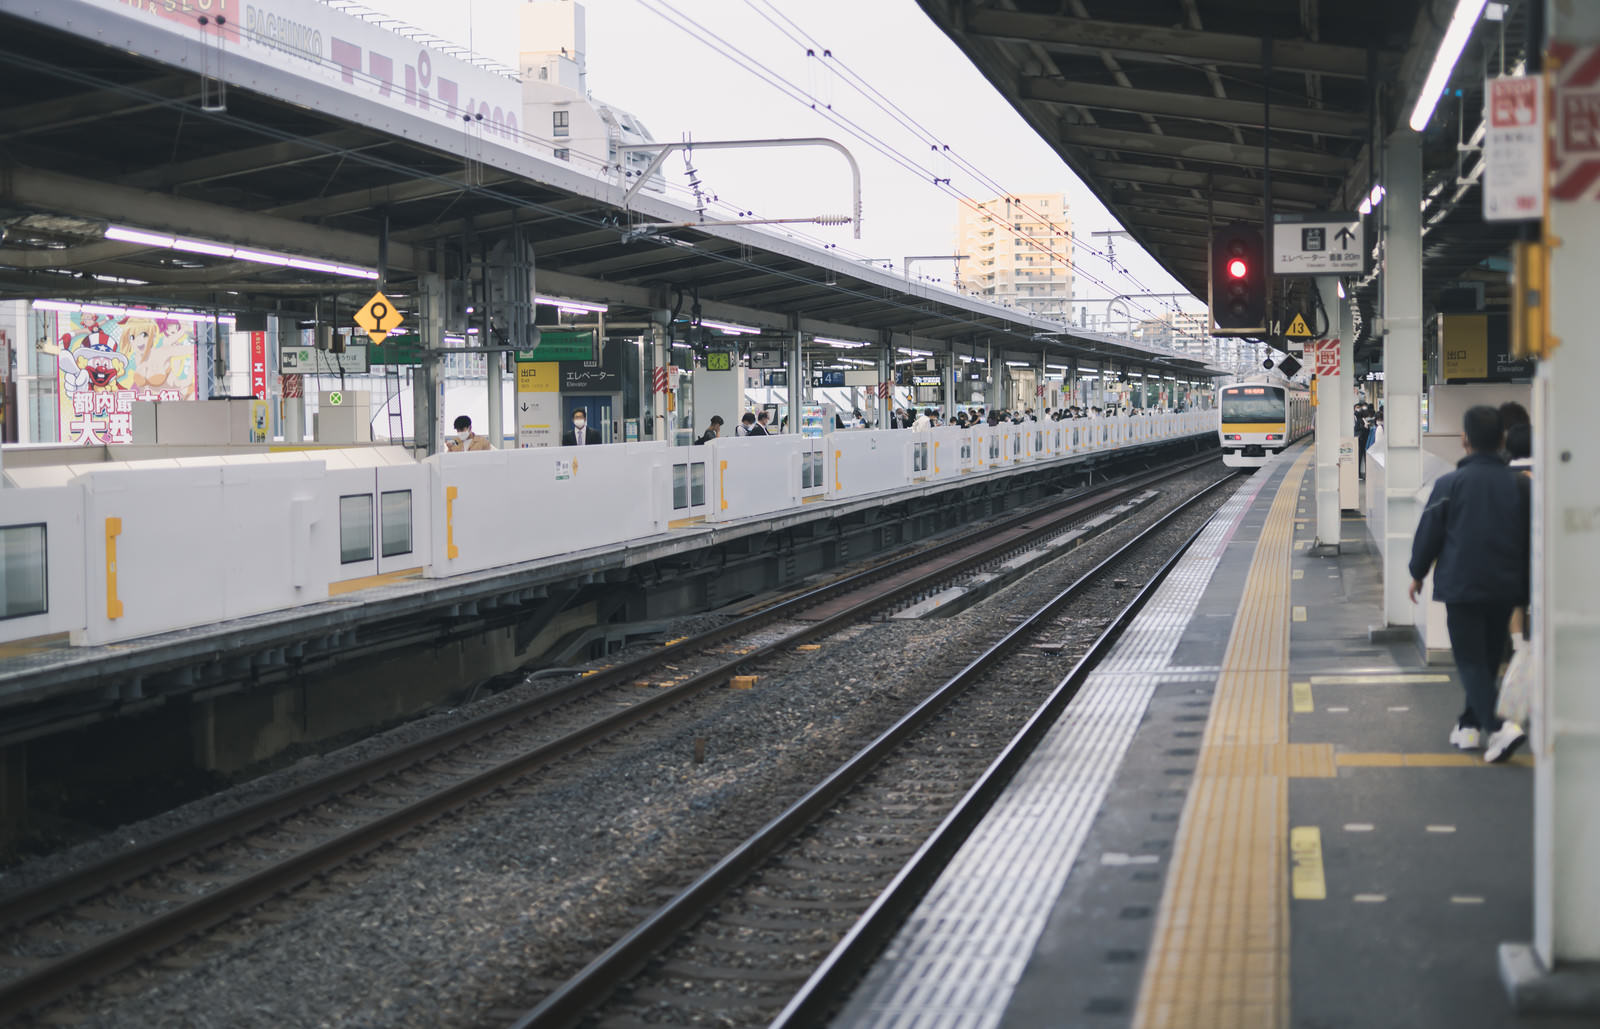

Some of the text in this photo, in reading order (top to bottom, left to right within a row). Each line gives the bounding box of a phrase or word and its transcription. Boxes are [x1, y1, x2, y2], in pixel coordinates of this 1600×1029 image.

[247, 4, 322, 64] PACHINKO
[1269, 320, 1280, 336] 14
[1292, 322, 1304, 334] 13
[521, 368, 536, 377] 出口
[566, 371, 615, 380] エレベーター
